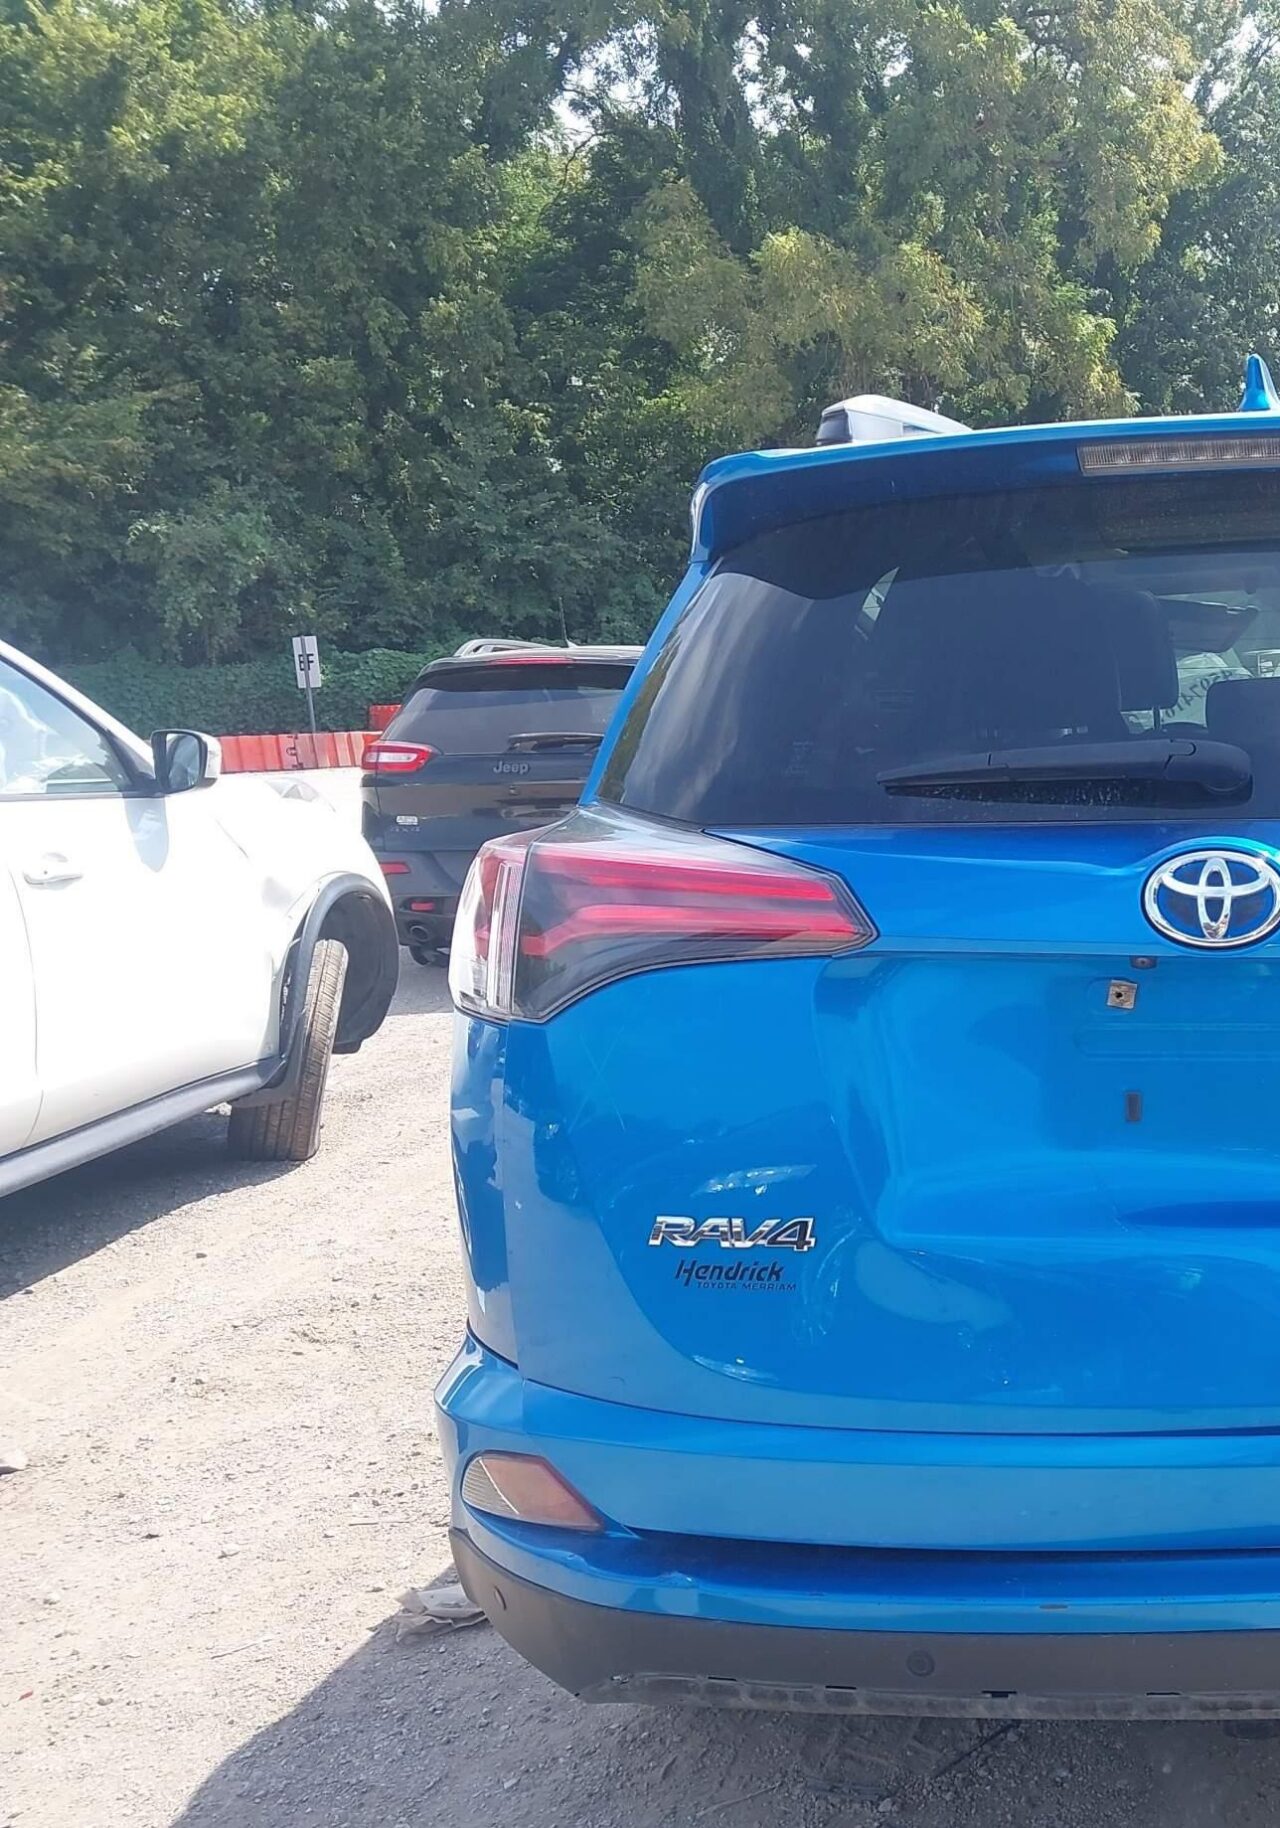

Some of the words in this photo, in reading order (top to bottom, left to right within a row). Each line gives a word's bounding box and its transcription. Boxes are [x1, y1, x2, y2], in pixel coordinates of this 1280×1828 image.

[493, 760, 530, 775] Jeep
[648, 1215, 817, 1252] RAV4
[674, 1259, 787, 1287] Hendrick
[697, 1281, 738, 1290] TOYOTA
[742, 1282, 797, 1292] MERRIAM
